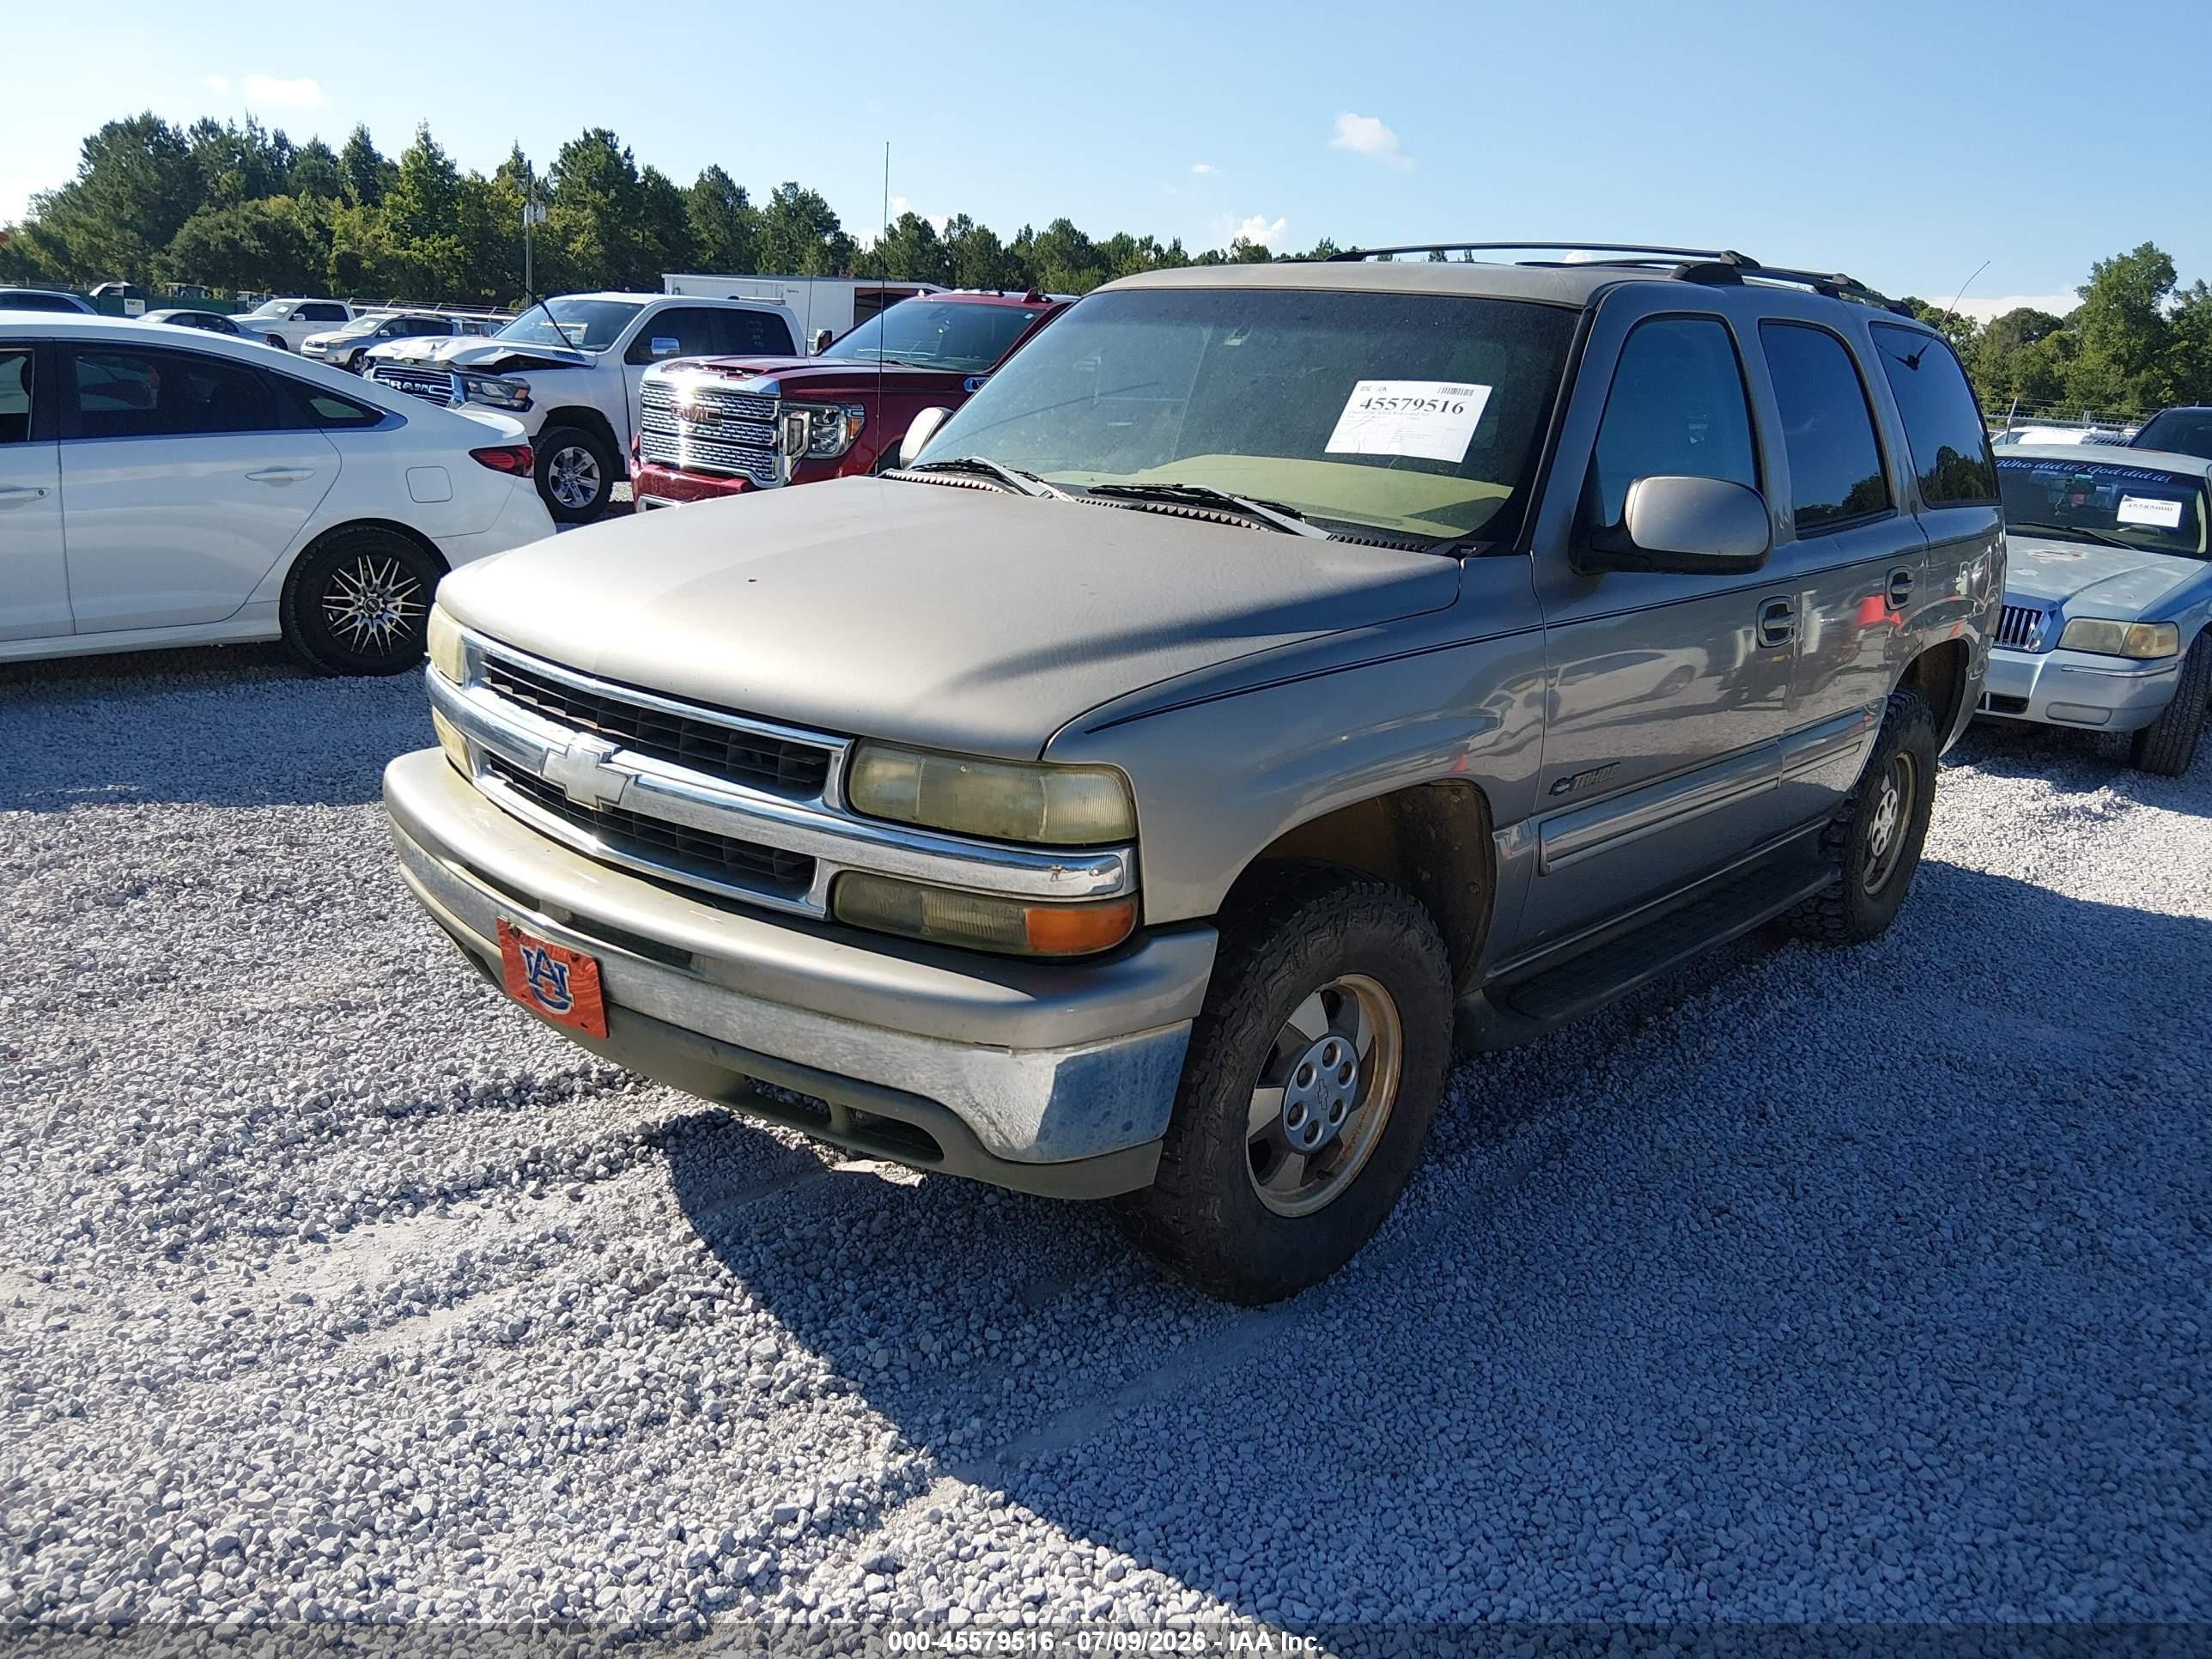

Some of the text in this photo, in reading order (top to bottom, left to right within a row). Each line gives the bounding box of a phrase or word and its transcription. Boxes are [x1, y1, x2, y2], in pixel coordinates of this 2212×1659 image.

[390, 380, 428, 392] RAM
[670, 403, 722, 425] GMC
[1359, 397, 1466, 415] 45579516
[1995, 459, 2033, 469] Who
[2034, 461, 2063, 471] did
[2087, 465, 2122, 476] God
[2123, 470, 2152, 480] did
